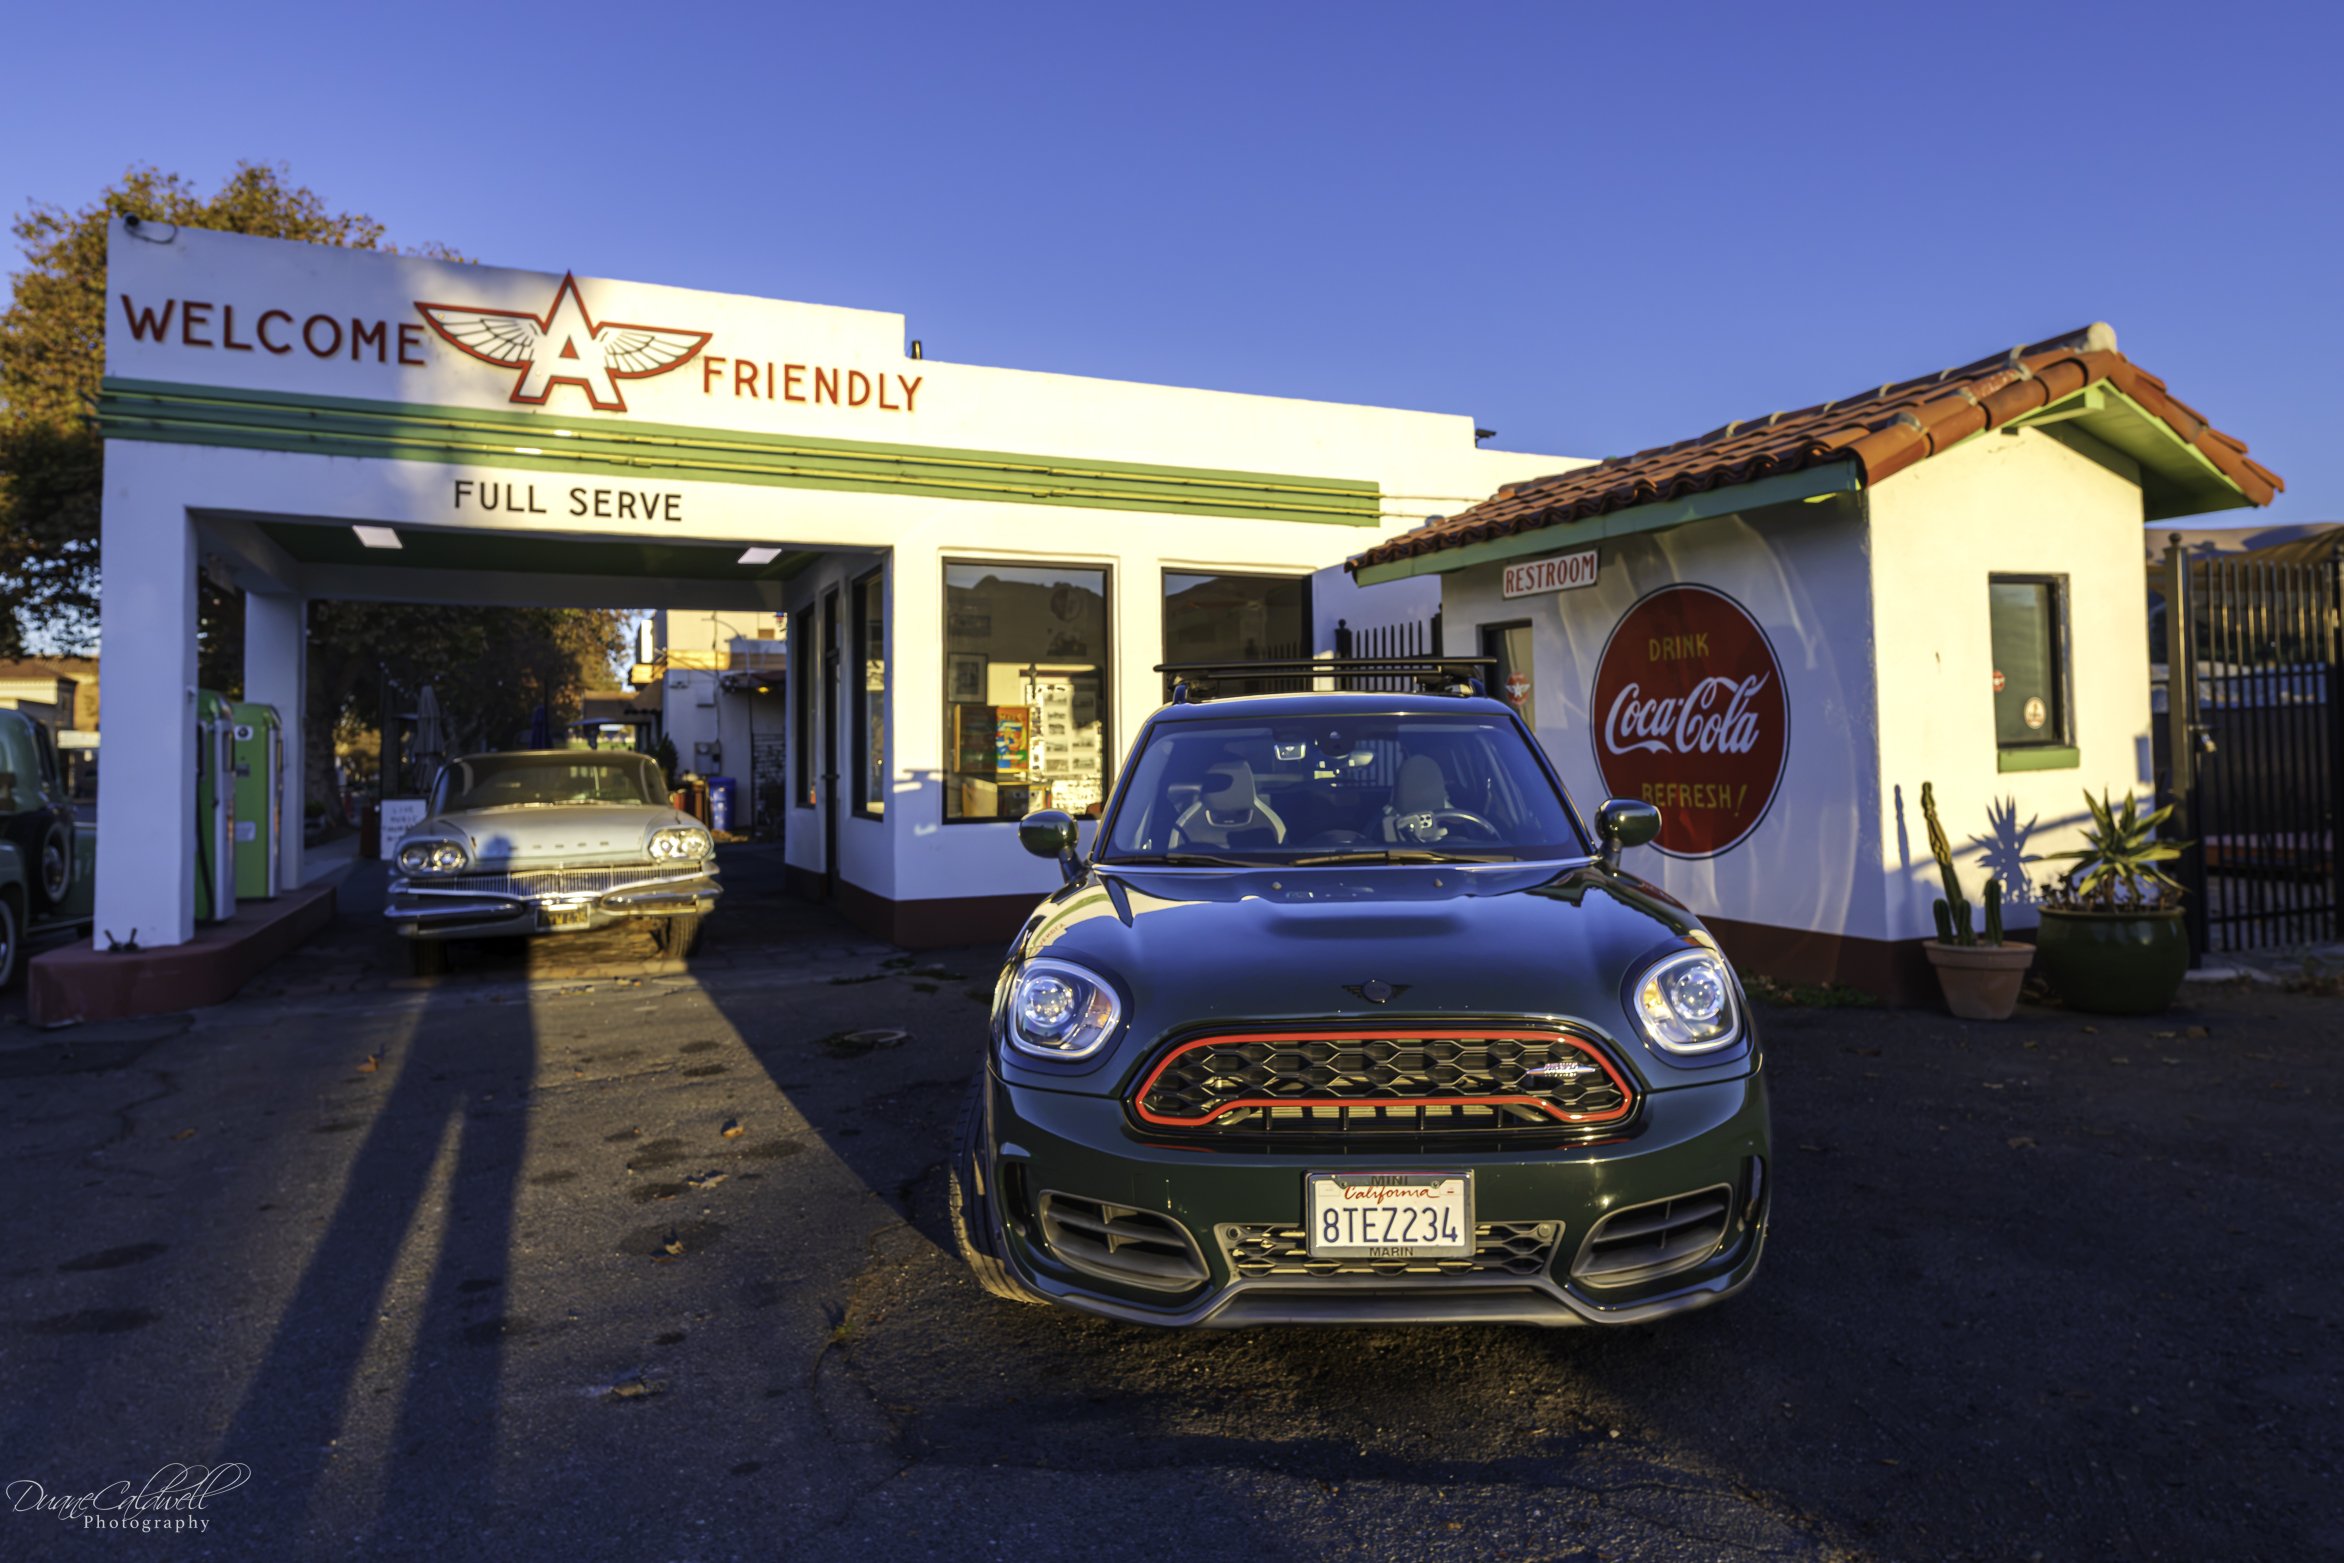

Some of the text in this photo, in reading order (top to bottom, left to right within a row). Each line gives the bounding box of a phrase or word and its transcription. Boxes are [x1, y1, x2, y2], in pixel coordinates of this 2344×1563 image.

[120, 293, 427, 367] WELCOME
[703, 355, 924, 412] FRIENDLY
[454, 479, 683, 522] FULL SERVE
[1505, 553, 1595, 595] RESTROOM
[1649, 632, 1710, 662] DRINK
[1605, 670, 1771, 756] Coca-Cola
[1344, 1185, 1441, 1205] California
[1371, 1175, 1409, 1187] MINI
[1323, 1206, 1459, 1243] 8TEZ234
[1369, 1247, 1415, 1257] MARIN
